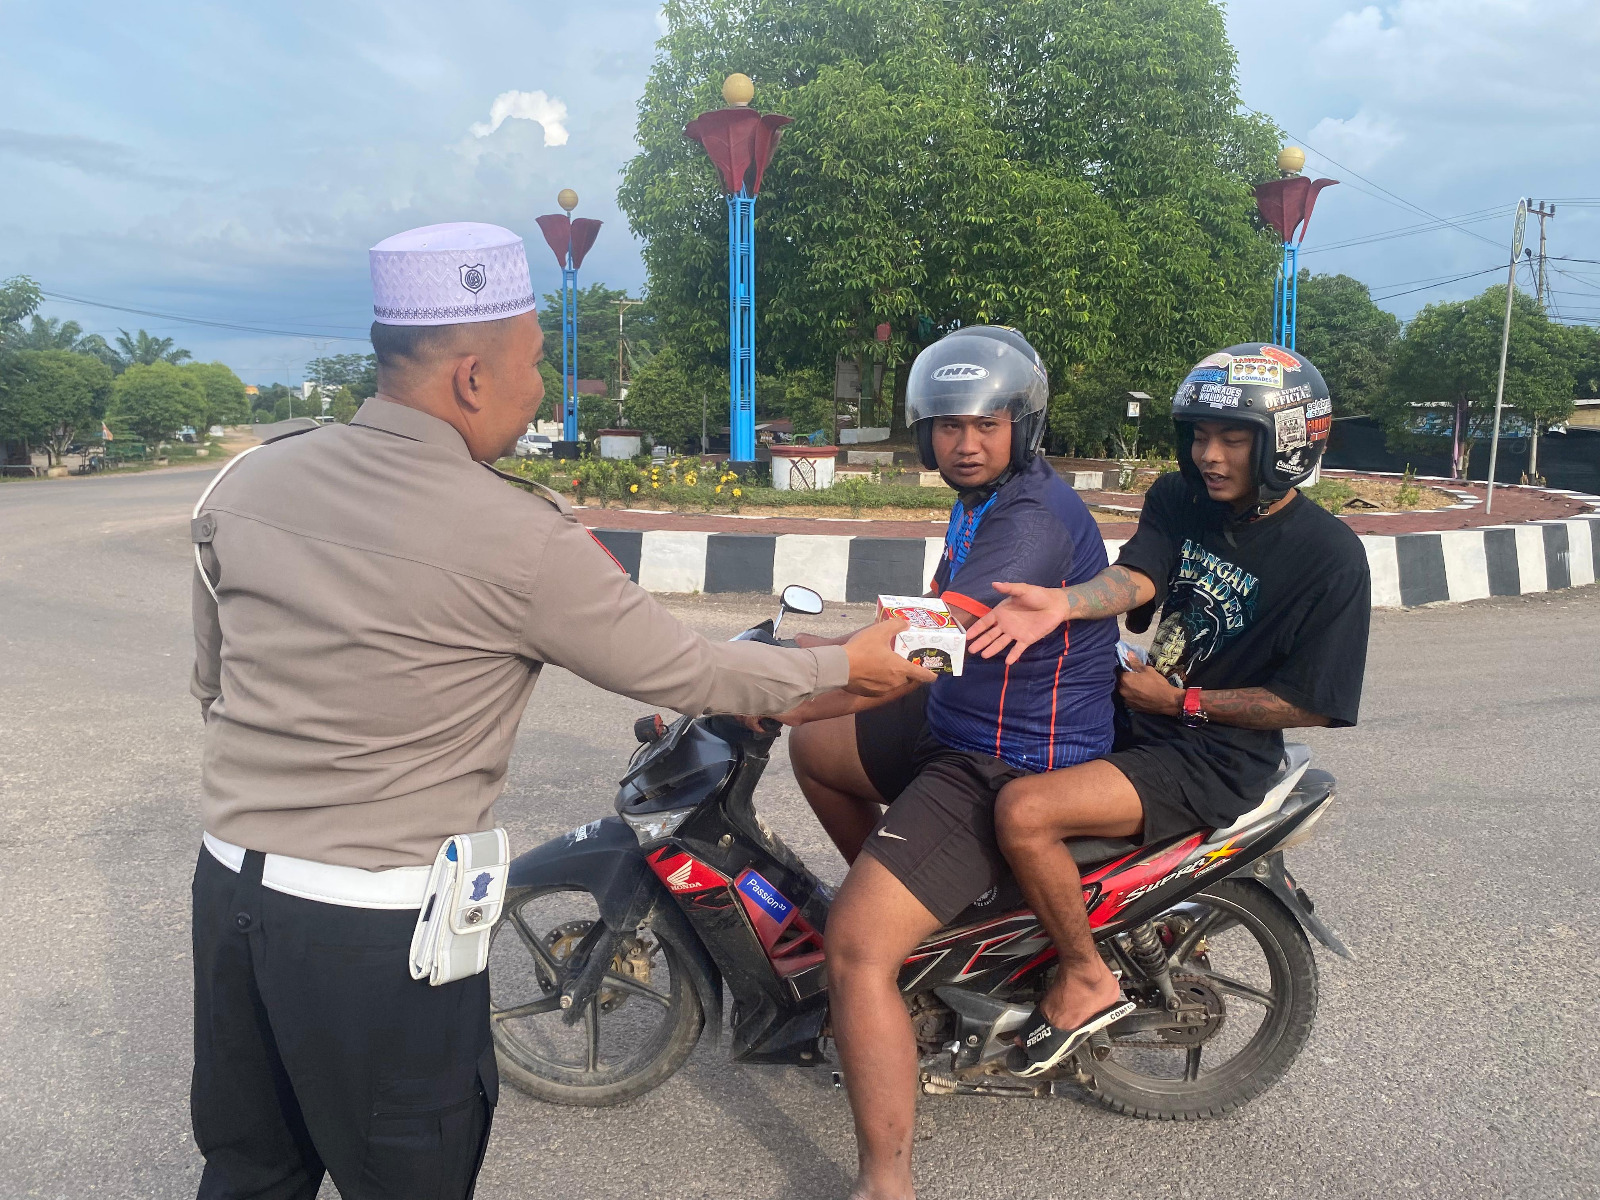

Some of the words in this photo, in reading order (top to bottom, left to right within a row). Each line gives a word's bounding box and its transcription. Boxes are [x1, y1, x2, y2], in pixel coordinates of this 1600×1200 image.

[936, 368, 982, 376] INK
[1201, 384, 1242, 397] COMRADES
[670, 881, 702, 891] HONDA
